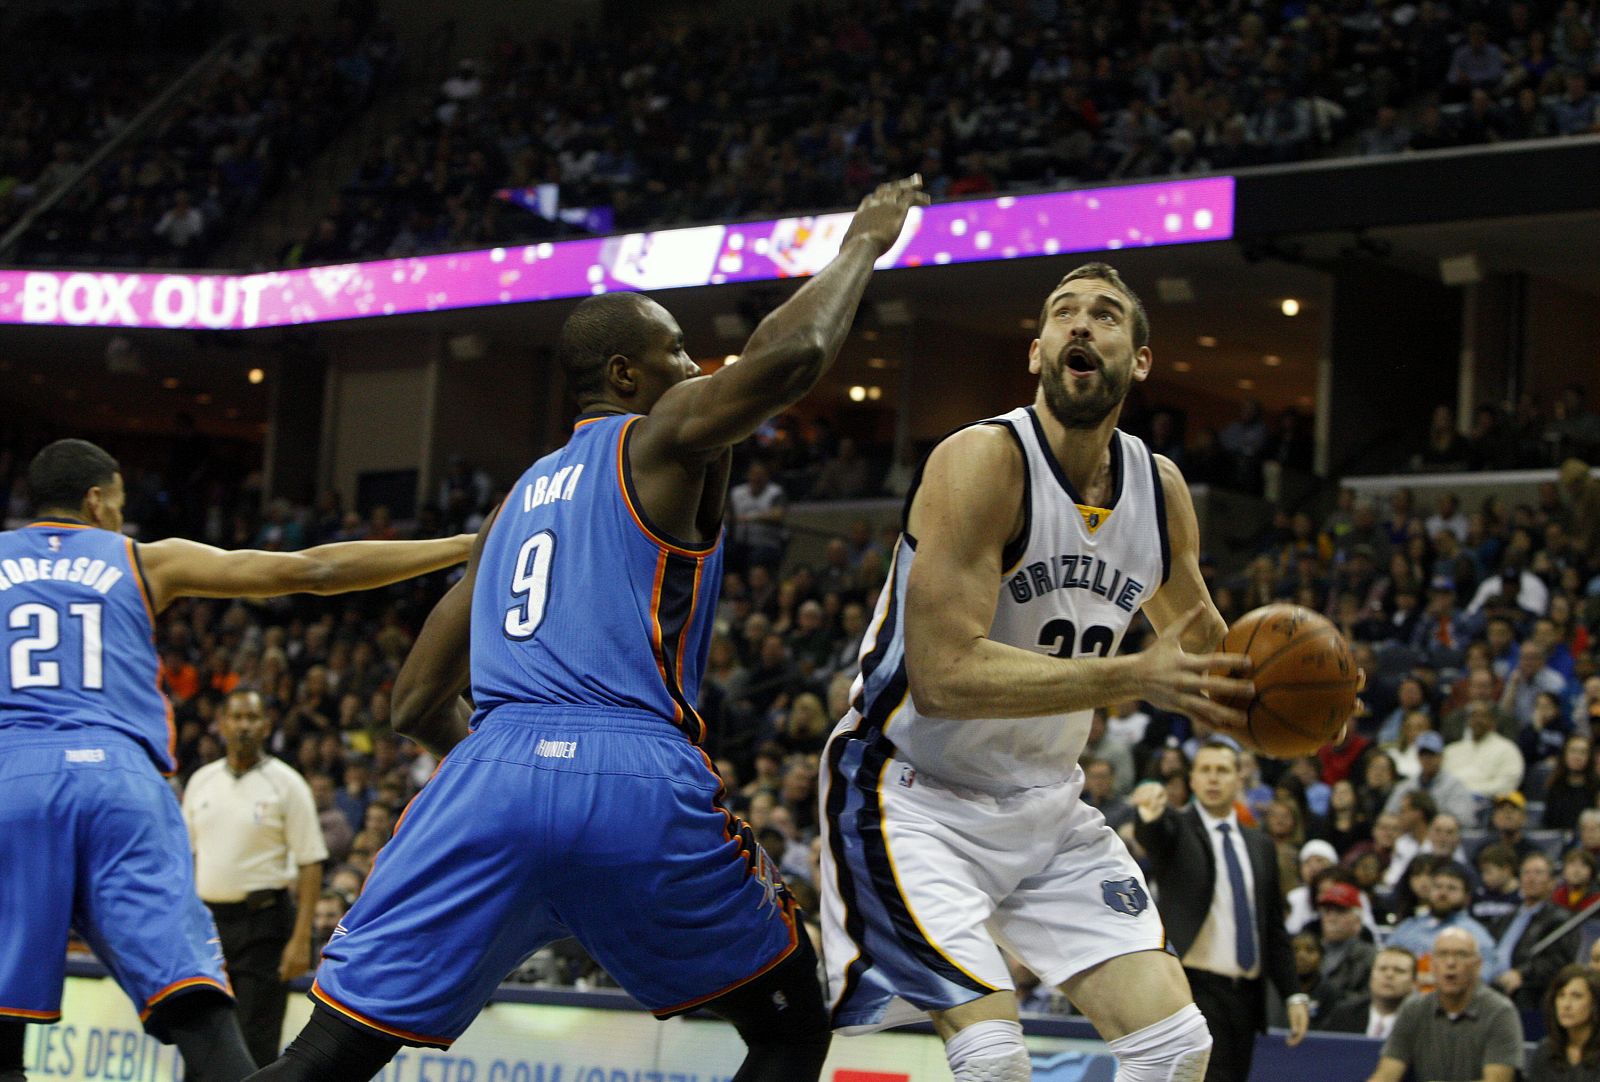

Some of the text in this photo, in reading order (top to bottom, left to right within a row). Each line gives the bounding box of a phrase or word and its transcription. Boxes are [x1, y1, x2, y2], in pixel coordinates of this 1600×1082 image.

[22, 272, 272, 329] BOX OUT
[503, 529, 557, 641] 9
[8, 602, 105, 691] 21
